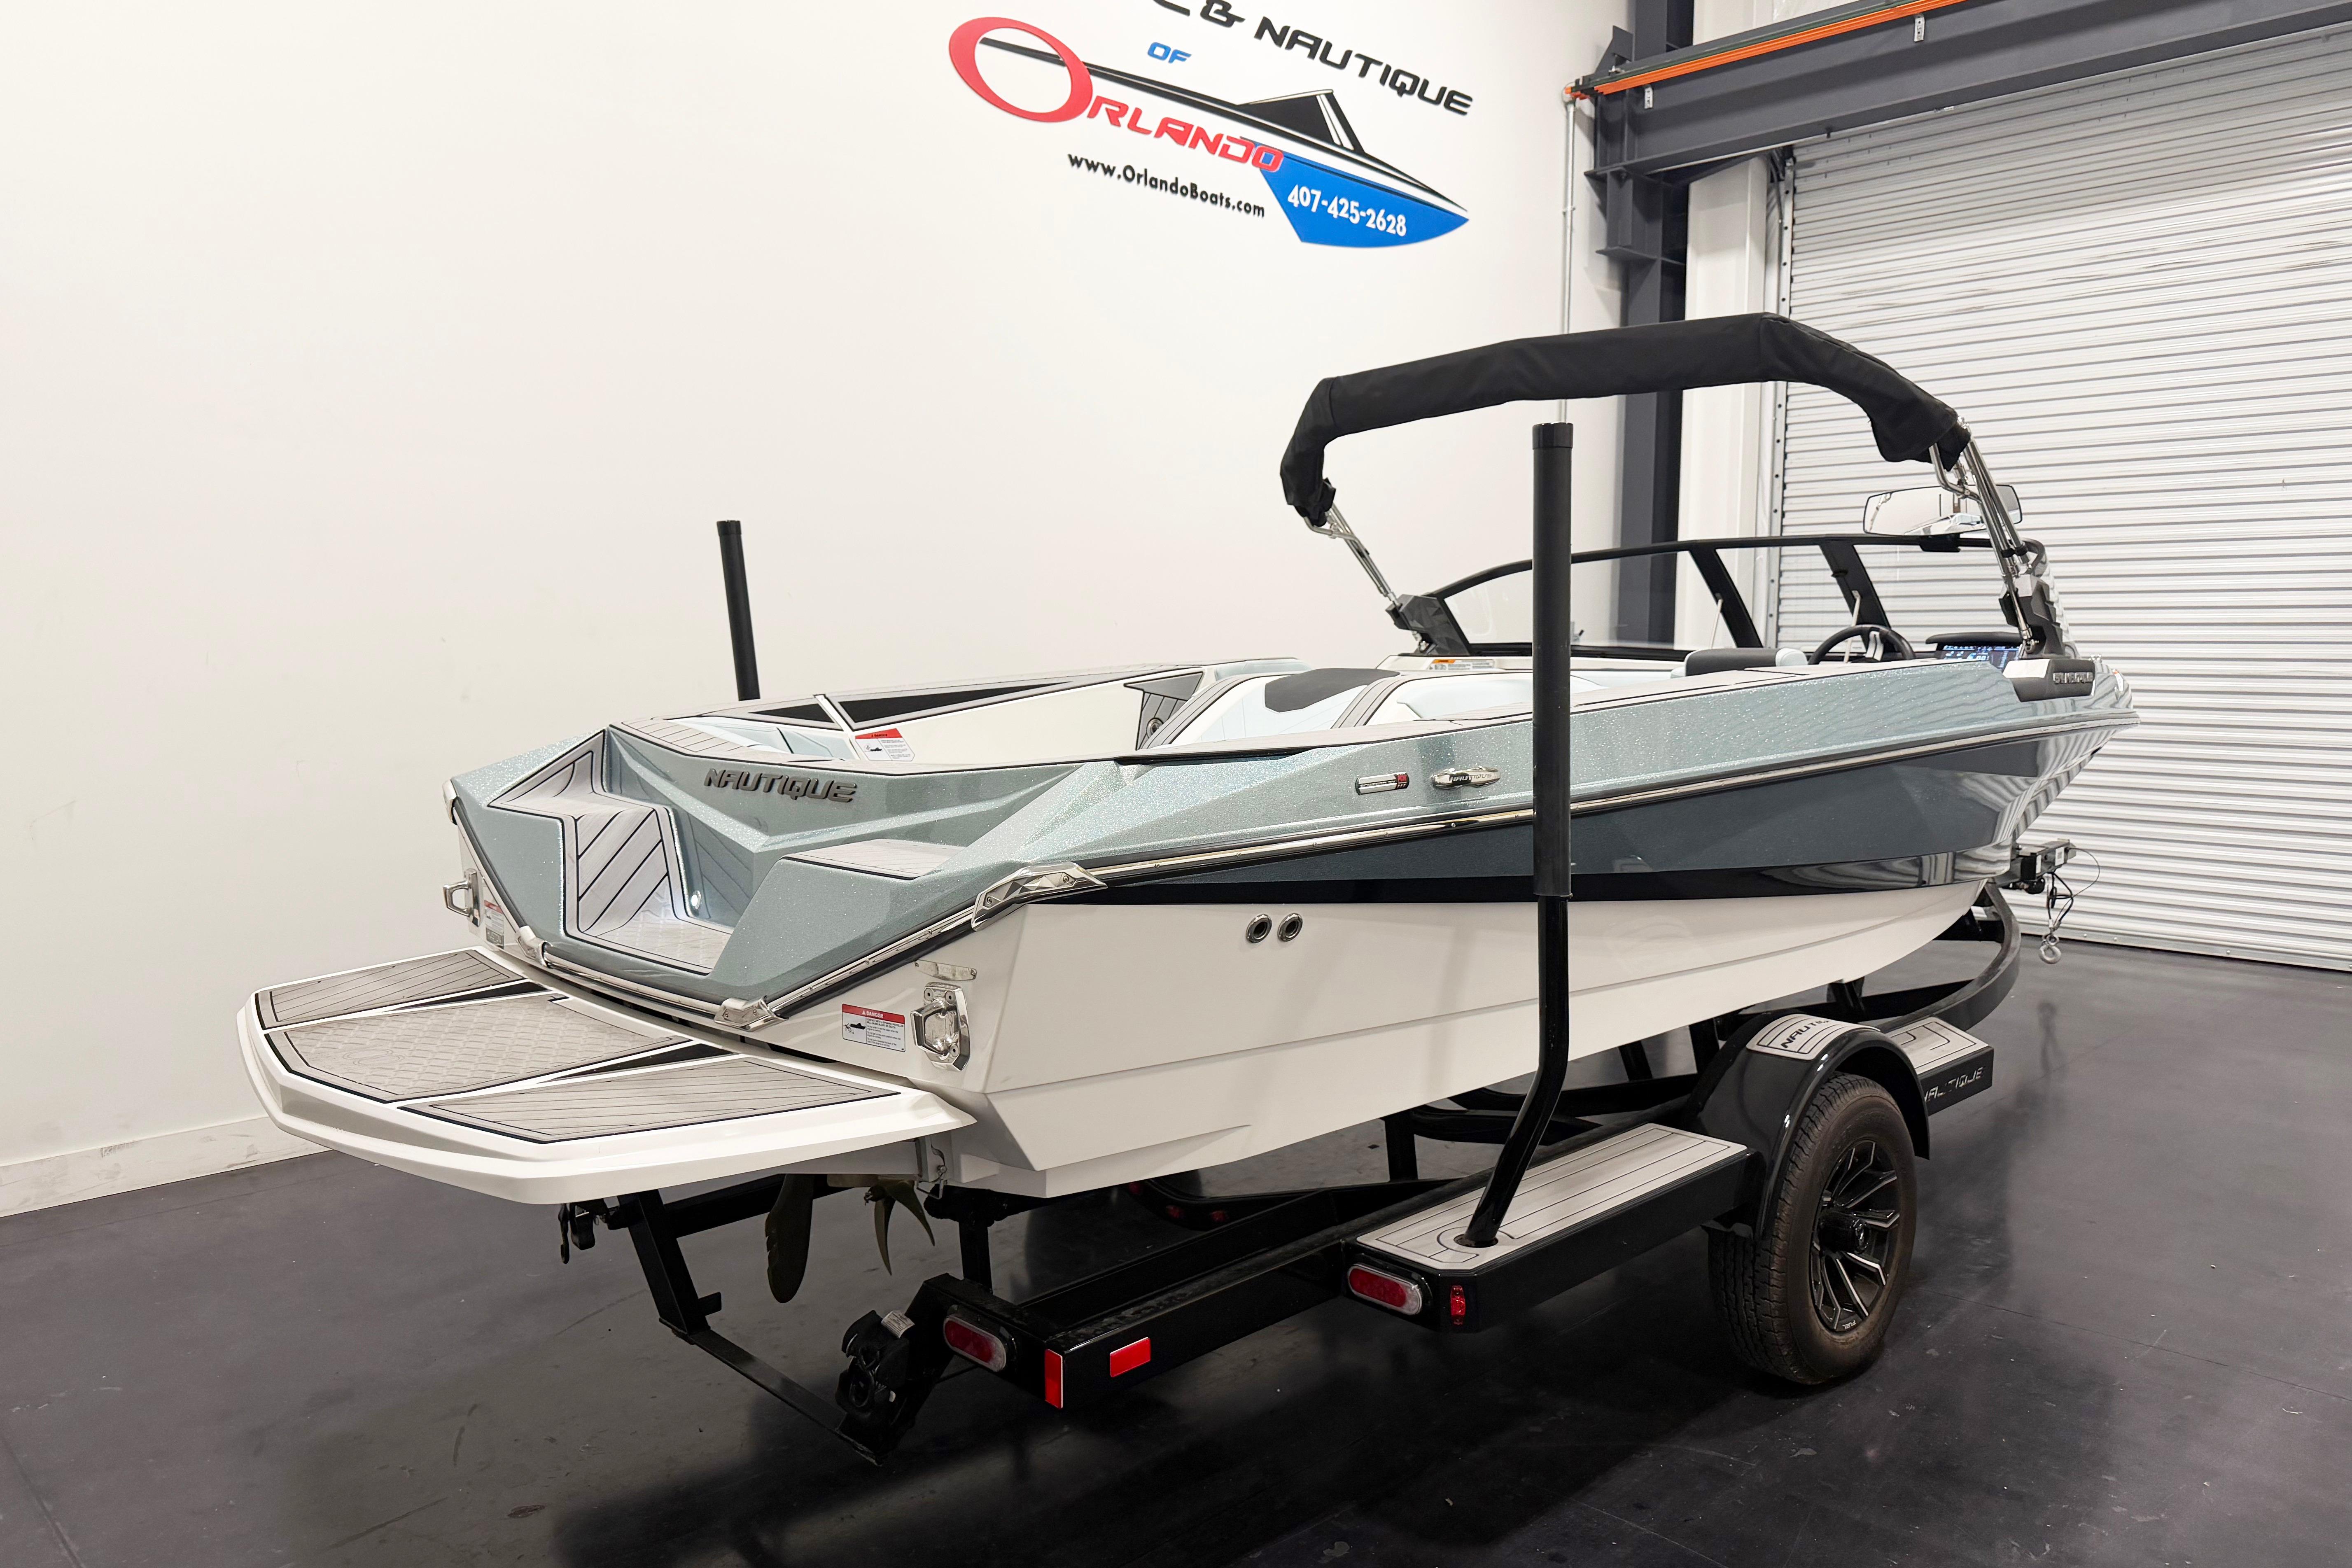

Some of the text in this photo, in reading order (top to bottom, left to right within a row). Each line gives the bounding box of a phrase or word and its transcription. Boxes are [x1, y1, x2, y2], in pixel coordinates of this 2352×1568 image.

[1148, 42, 1192, 63] OF
[1254, 16, 1473, 115] NAUTIQUE
[1068, 153, 1265, 218] www.OrlandoBoats.com
[1287, 184, 1407, 237] 407-425-2628
[703, 768, 857, 803] NAUTIQUE
[1449, 774, 1492, 782] NAUTIQUE
[1842, 1320, 1856, 1329] FUEL
